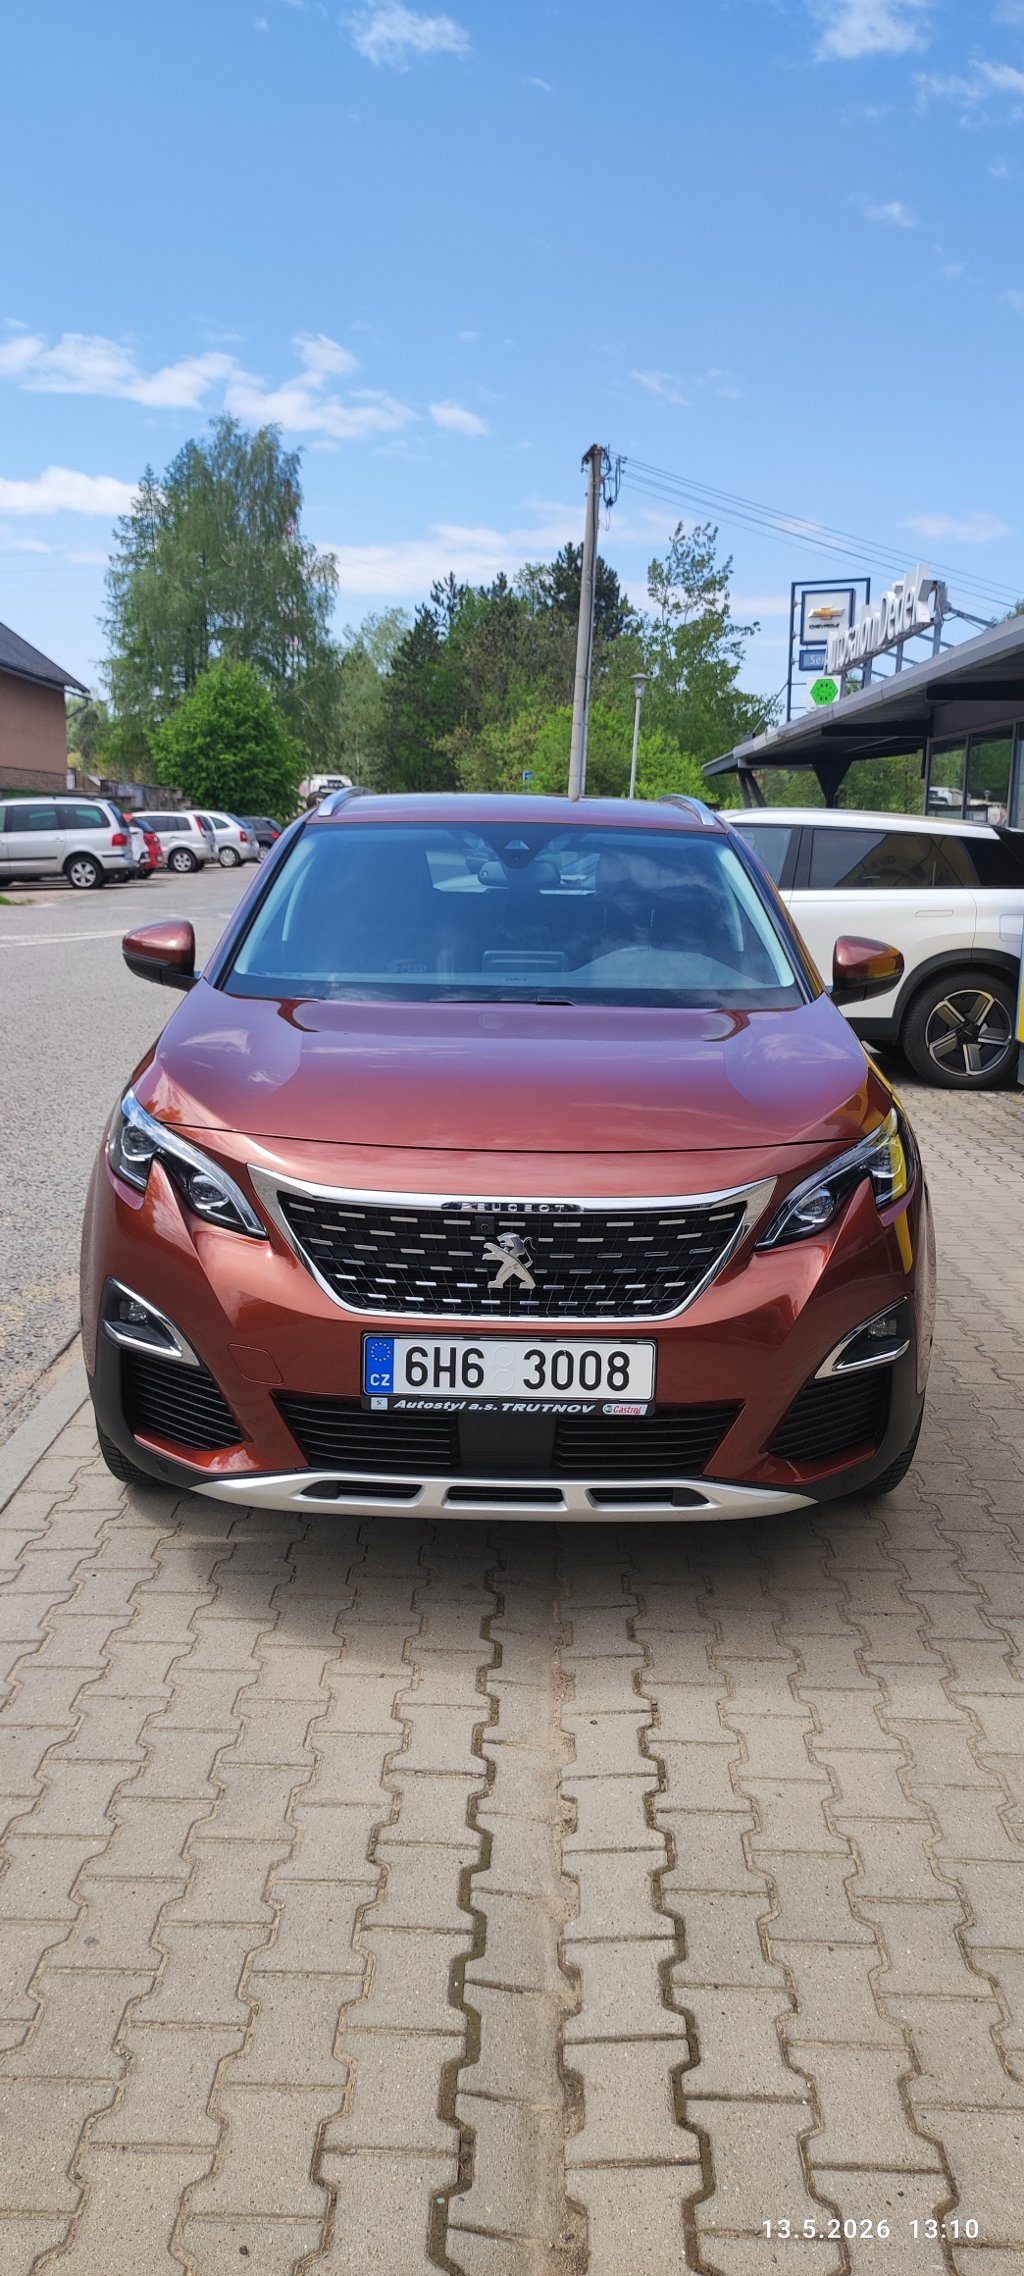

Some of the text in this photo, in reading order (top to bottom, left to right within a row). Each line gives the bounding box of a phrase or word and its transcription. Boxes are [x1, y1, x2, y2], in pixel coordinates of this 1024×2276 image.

[460, 1202, 565, 1213] PEUGEOT
[405, 1345, 631, 1392] 6H6 3008
[370, 1373, 391, 1386] CZ
[393, 1399, 596, 1414] Autostyl a.s. TRUTNOV
[613, 1405, 642, 1415] Castrol
